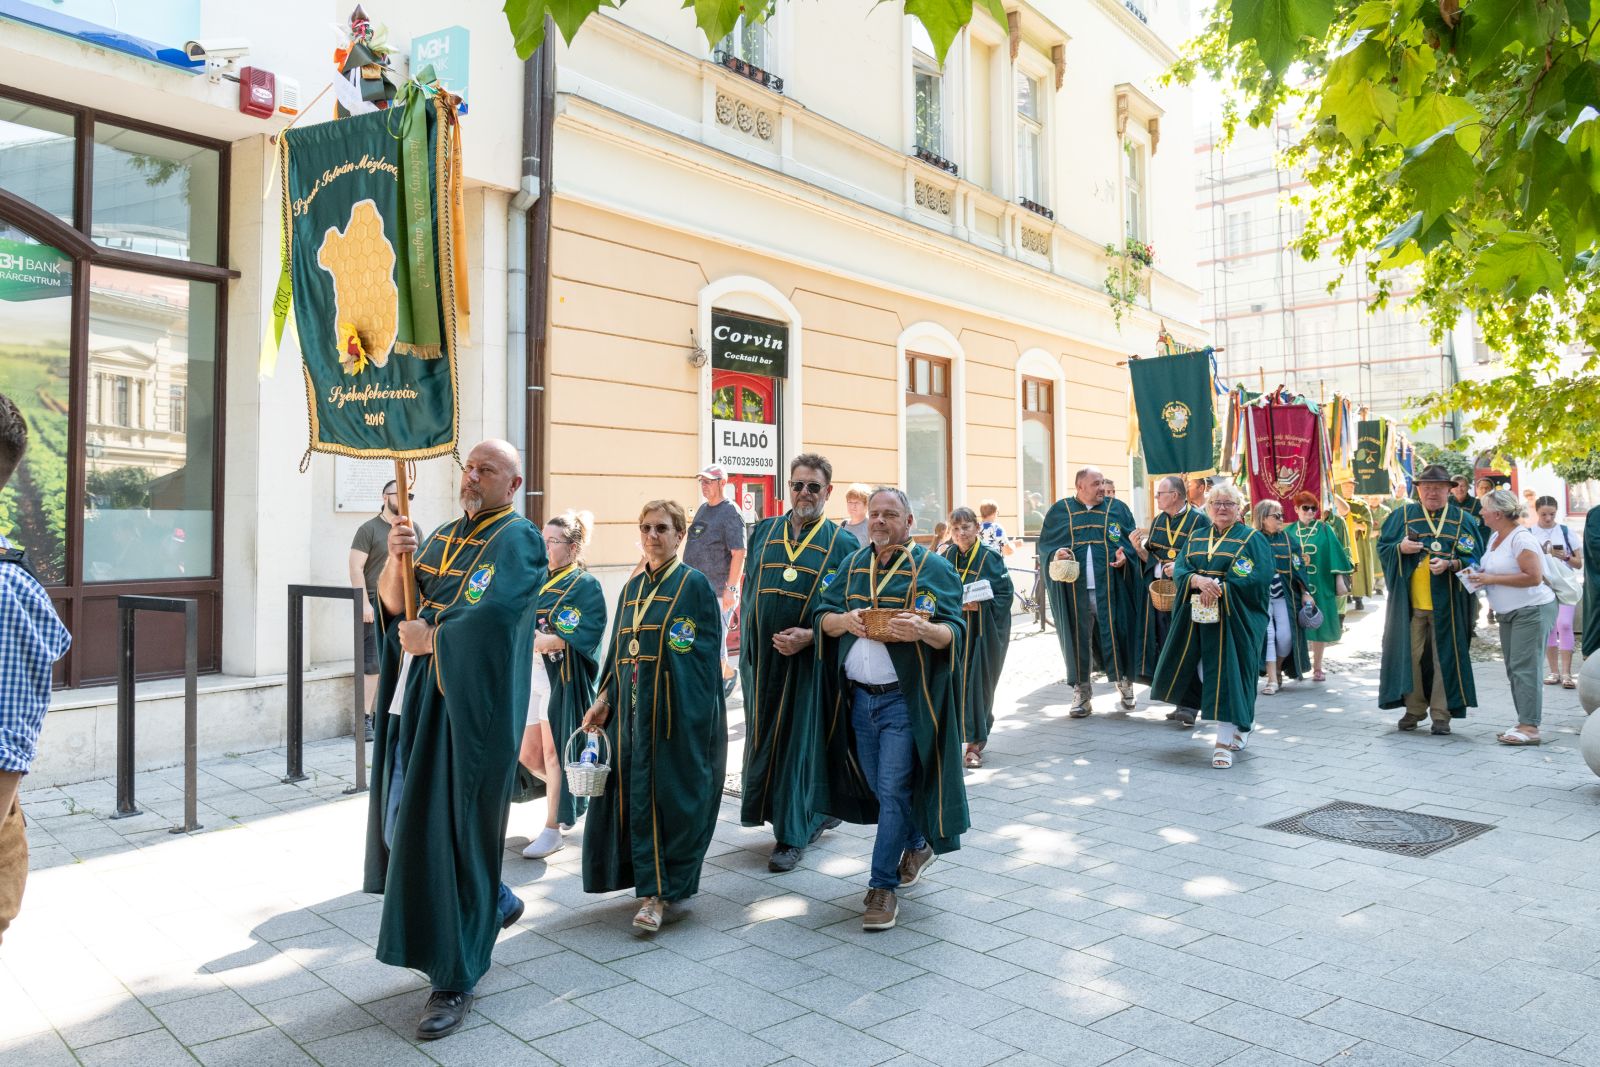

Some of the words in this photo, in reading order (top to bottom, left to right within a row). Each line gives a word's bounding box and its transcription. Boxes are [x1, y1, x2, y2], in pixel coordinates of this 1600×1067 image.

[417, 58, 449, 73] BNK
[321, 160, 354, 187] István
[0, 252, 23, 271] BH
[26, 259, 61, 275] BANK
[273, 287, 290, 319] 2025
[713, 325, 784, 351] Corvin
[724, 351, 759, 364] Cocktail
[759, 356, 774, 366] bar
[364, 411, 386, 427] 2016
[723, 430, 769, 449] ELADÓ
[718, 455, 774, 468] +36703295030
